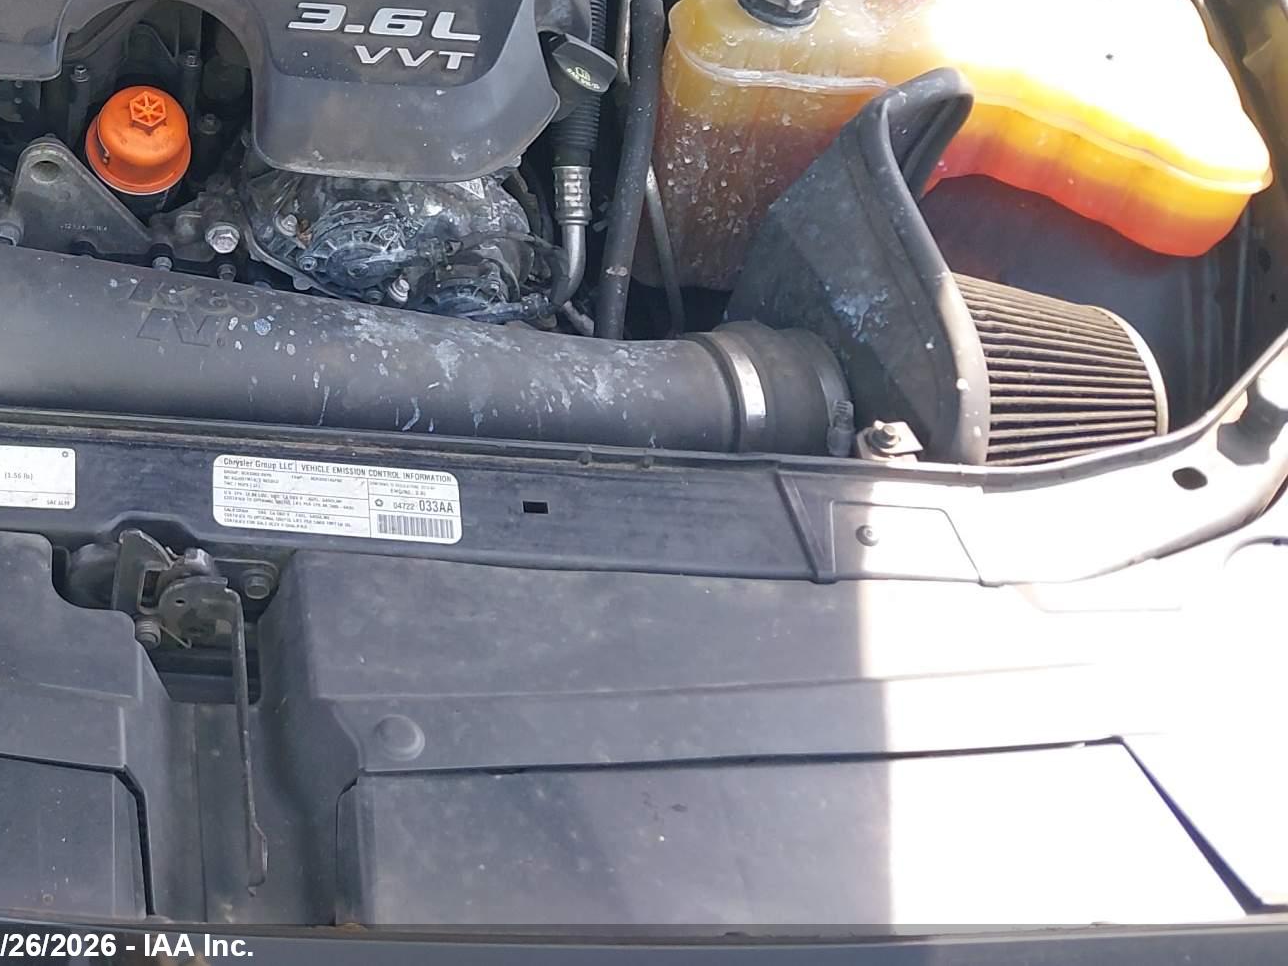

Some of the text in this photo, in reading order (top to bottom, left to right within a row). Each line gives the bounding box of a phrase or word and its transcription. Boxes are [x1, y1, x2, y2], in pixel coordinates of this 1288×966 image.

[287, 1, 481, 43] 3.6L
[353, 44, 476, 71] VVT
[223, 457, 293, 471] Chrysler Group LLC
[300, 464, 452, 483] VEHICLE EMISSION CONTROL INFORMATION
[418, 499, 454, 514] 033AA
